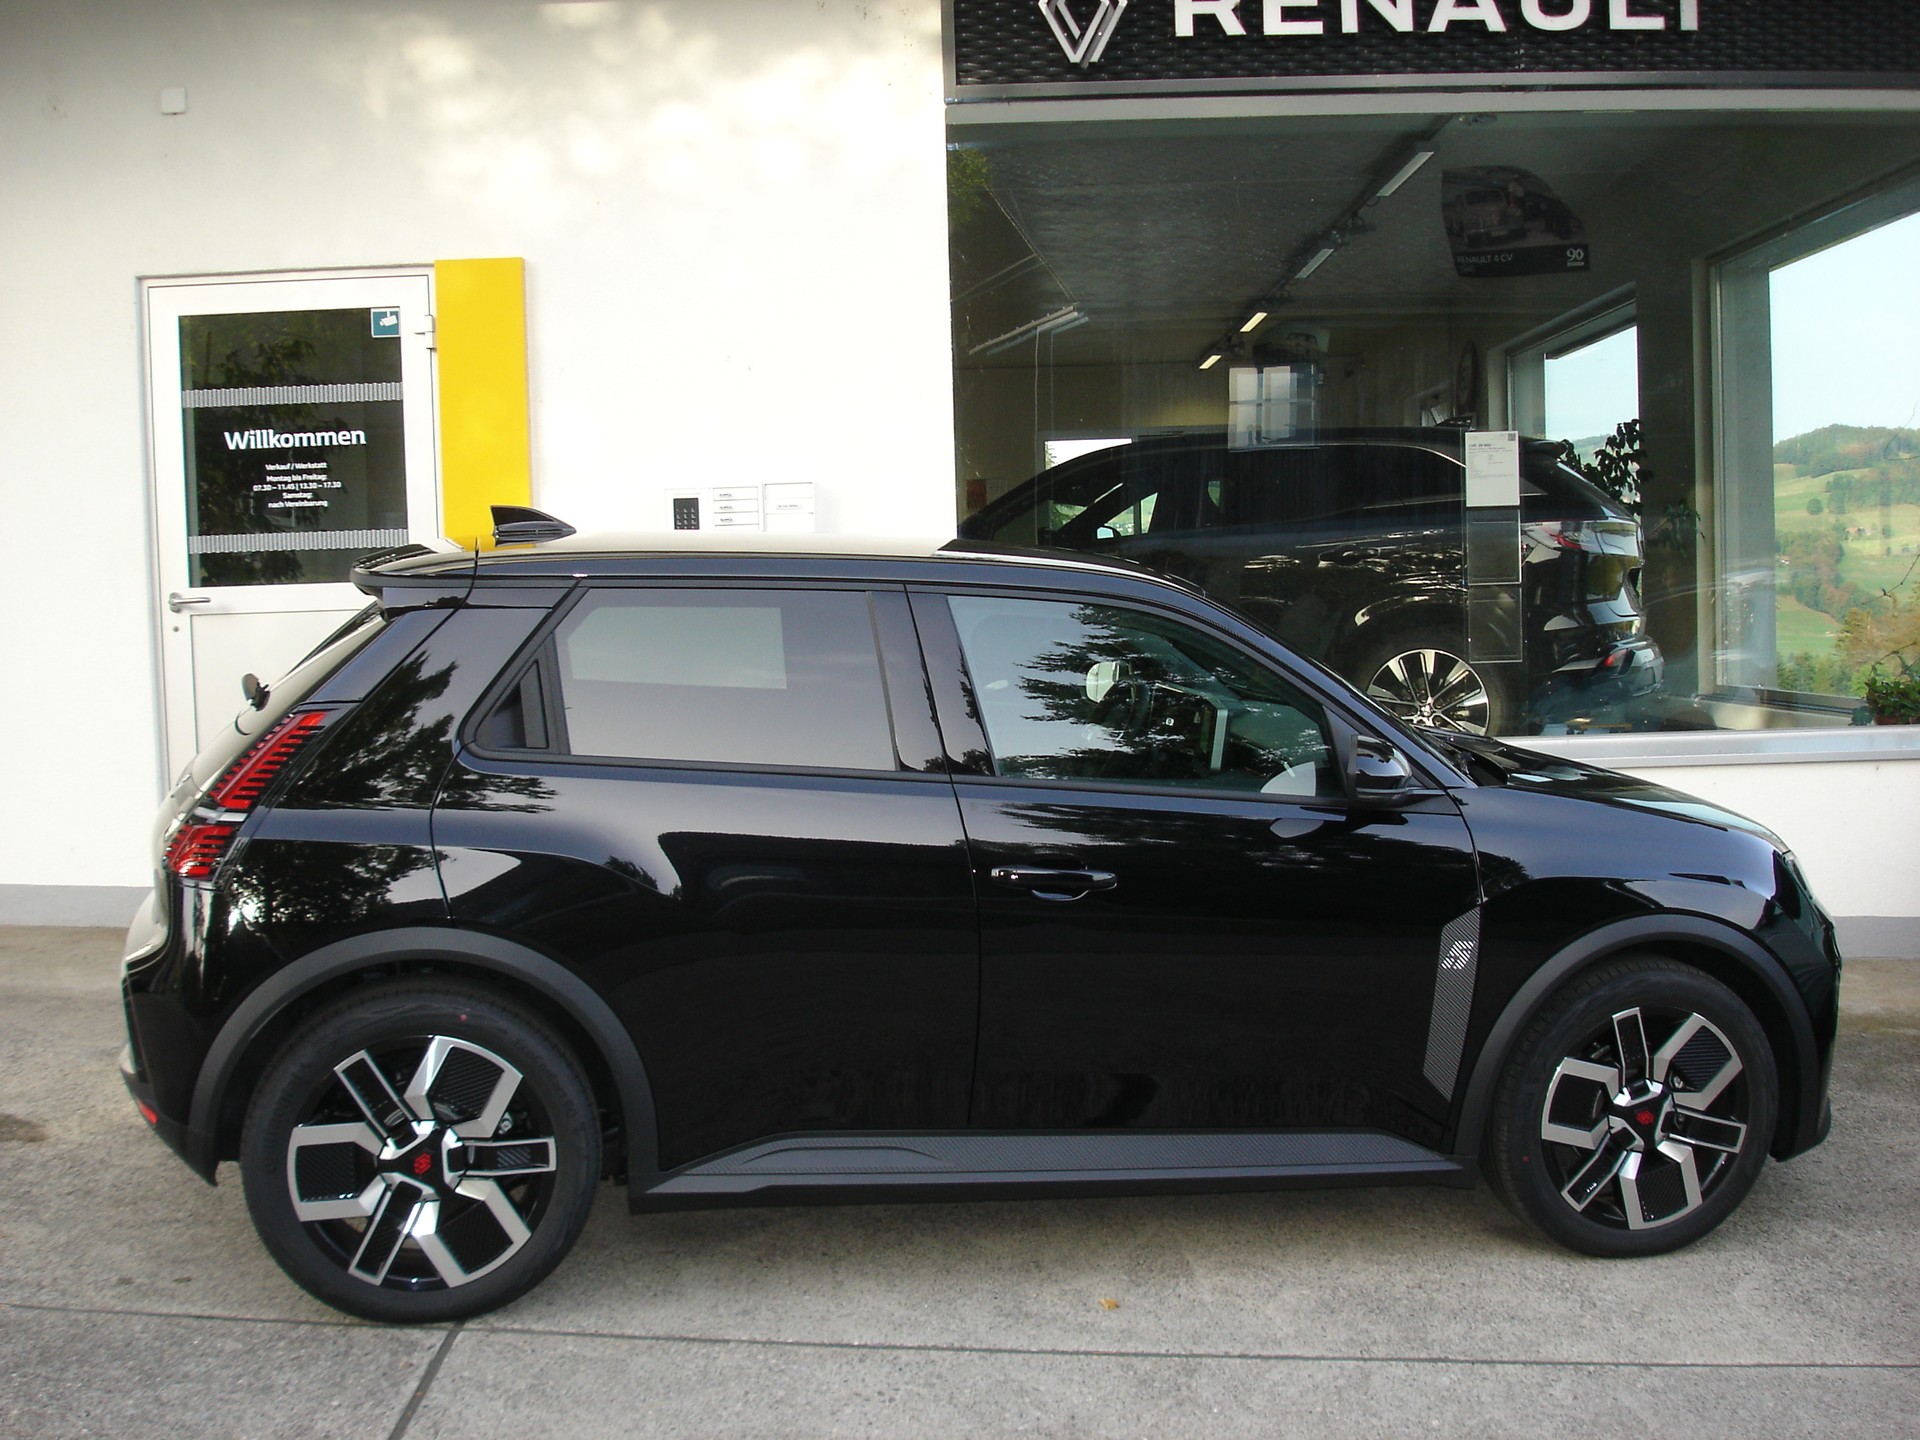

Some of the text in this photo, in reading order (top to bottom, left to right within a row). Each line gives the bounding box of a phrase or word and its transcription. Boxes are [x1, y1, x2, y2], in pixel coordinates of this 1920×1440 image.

[1456, 255, 1492, 264] RENAULT
[223, 429, 367, 450] Willkommen
[265, 463, 291, 471] Verkauf
[295, 462, 328, 470] Werkstatt
[266, 474, 292, 483] Montag
[285, 500, 329, 508] Vereinbarung
